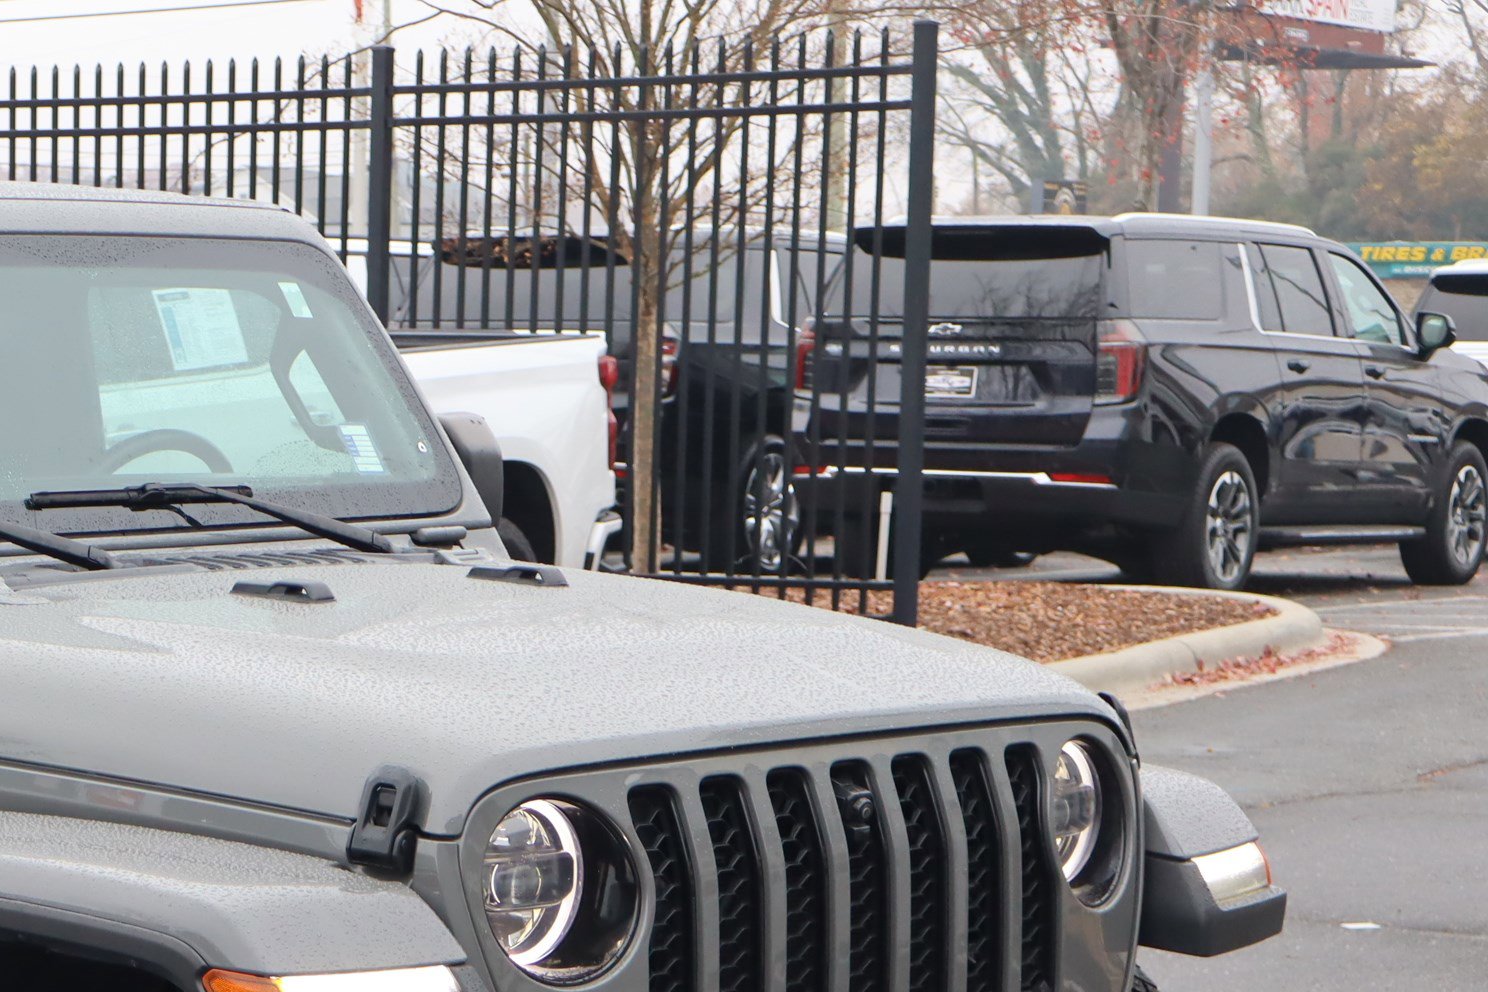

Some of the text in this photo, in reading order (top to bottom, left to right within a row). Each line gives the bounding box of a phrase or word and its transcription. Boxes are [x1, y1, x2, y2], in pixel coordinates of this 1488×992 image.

[1360, 245, 1488, 261] TIRES & BR
[889, 344, 1001, 354] SURBAN
